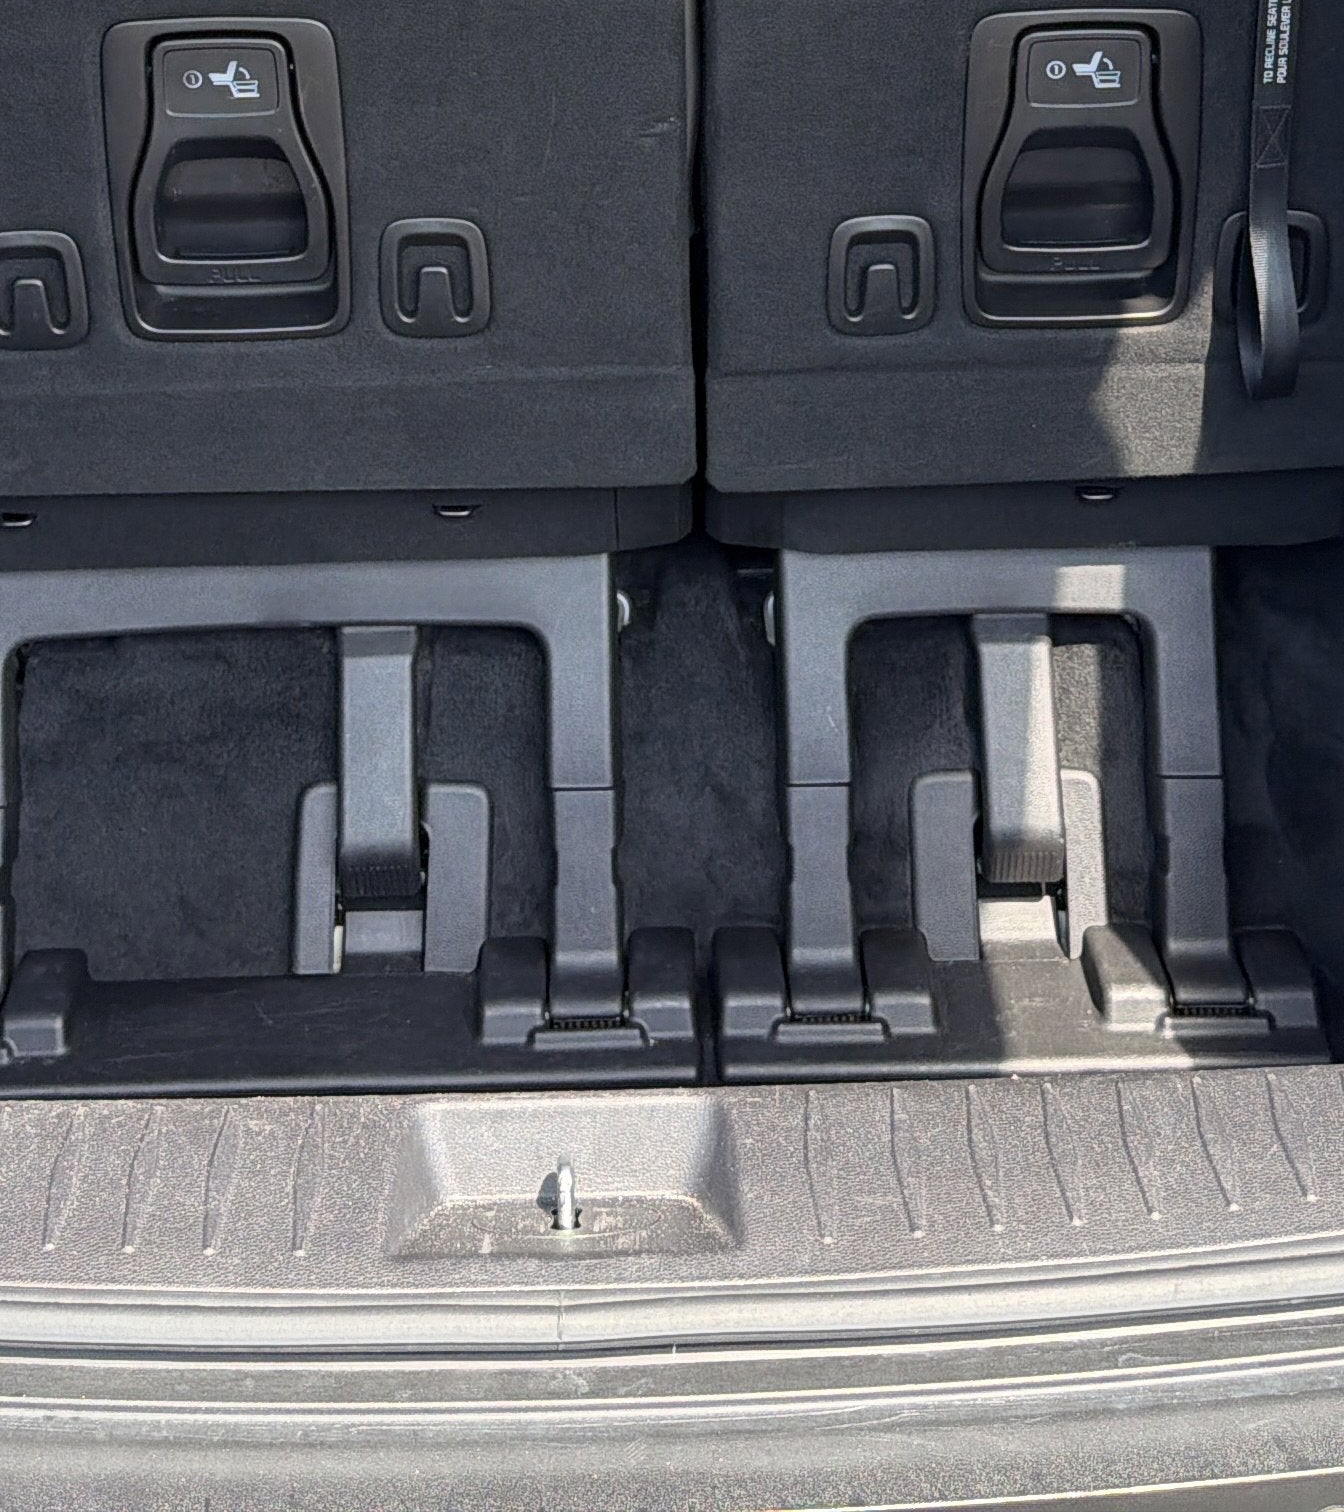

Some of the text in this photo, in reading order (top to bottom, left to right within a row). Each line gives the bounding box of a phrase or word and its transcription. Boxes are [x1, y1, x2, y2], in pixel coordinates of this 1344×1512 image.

[1278, 6, 1292, 55] SOULEVER
[1264, 31, 1276, 69] RECLINE
[1263, 69, 1274, 84] TO
[1276, 55, 1287, 84] POUR
